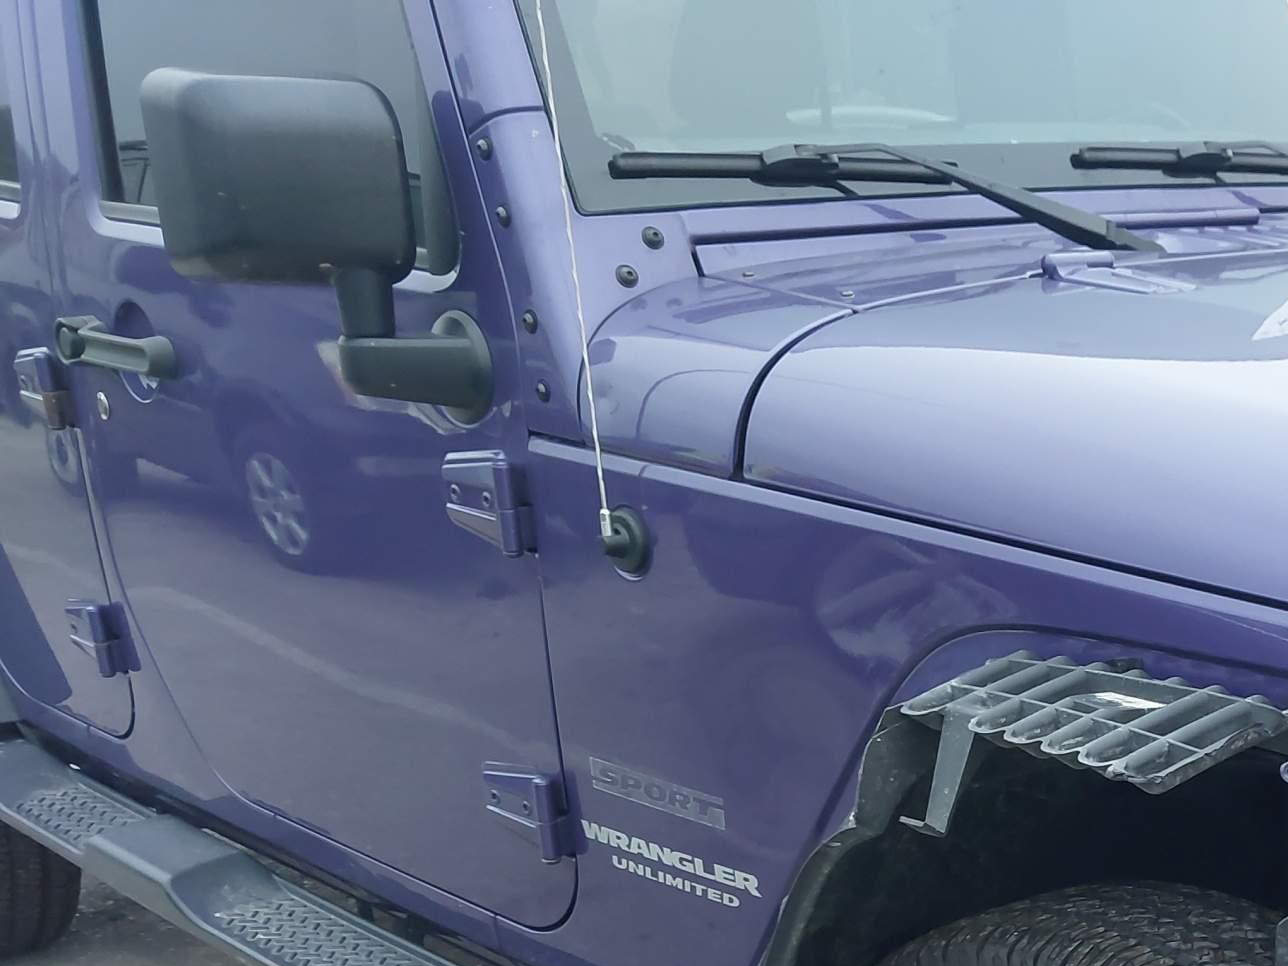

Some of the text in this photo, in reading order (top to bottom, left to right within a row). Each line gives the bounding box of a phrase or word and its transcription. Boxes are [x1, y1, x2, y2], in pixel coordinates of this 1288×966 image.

[592, 763, 725, 820] SPORT
[581, 819, 763, 898] WRANGLER
[611, 855, 740, 908] UNLIMITED
